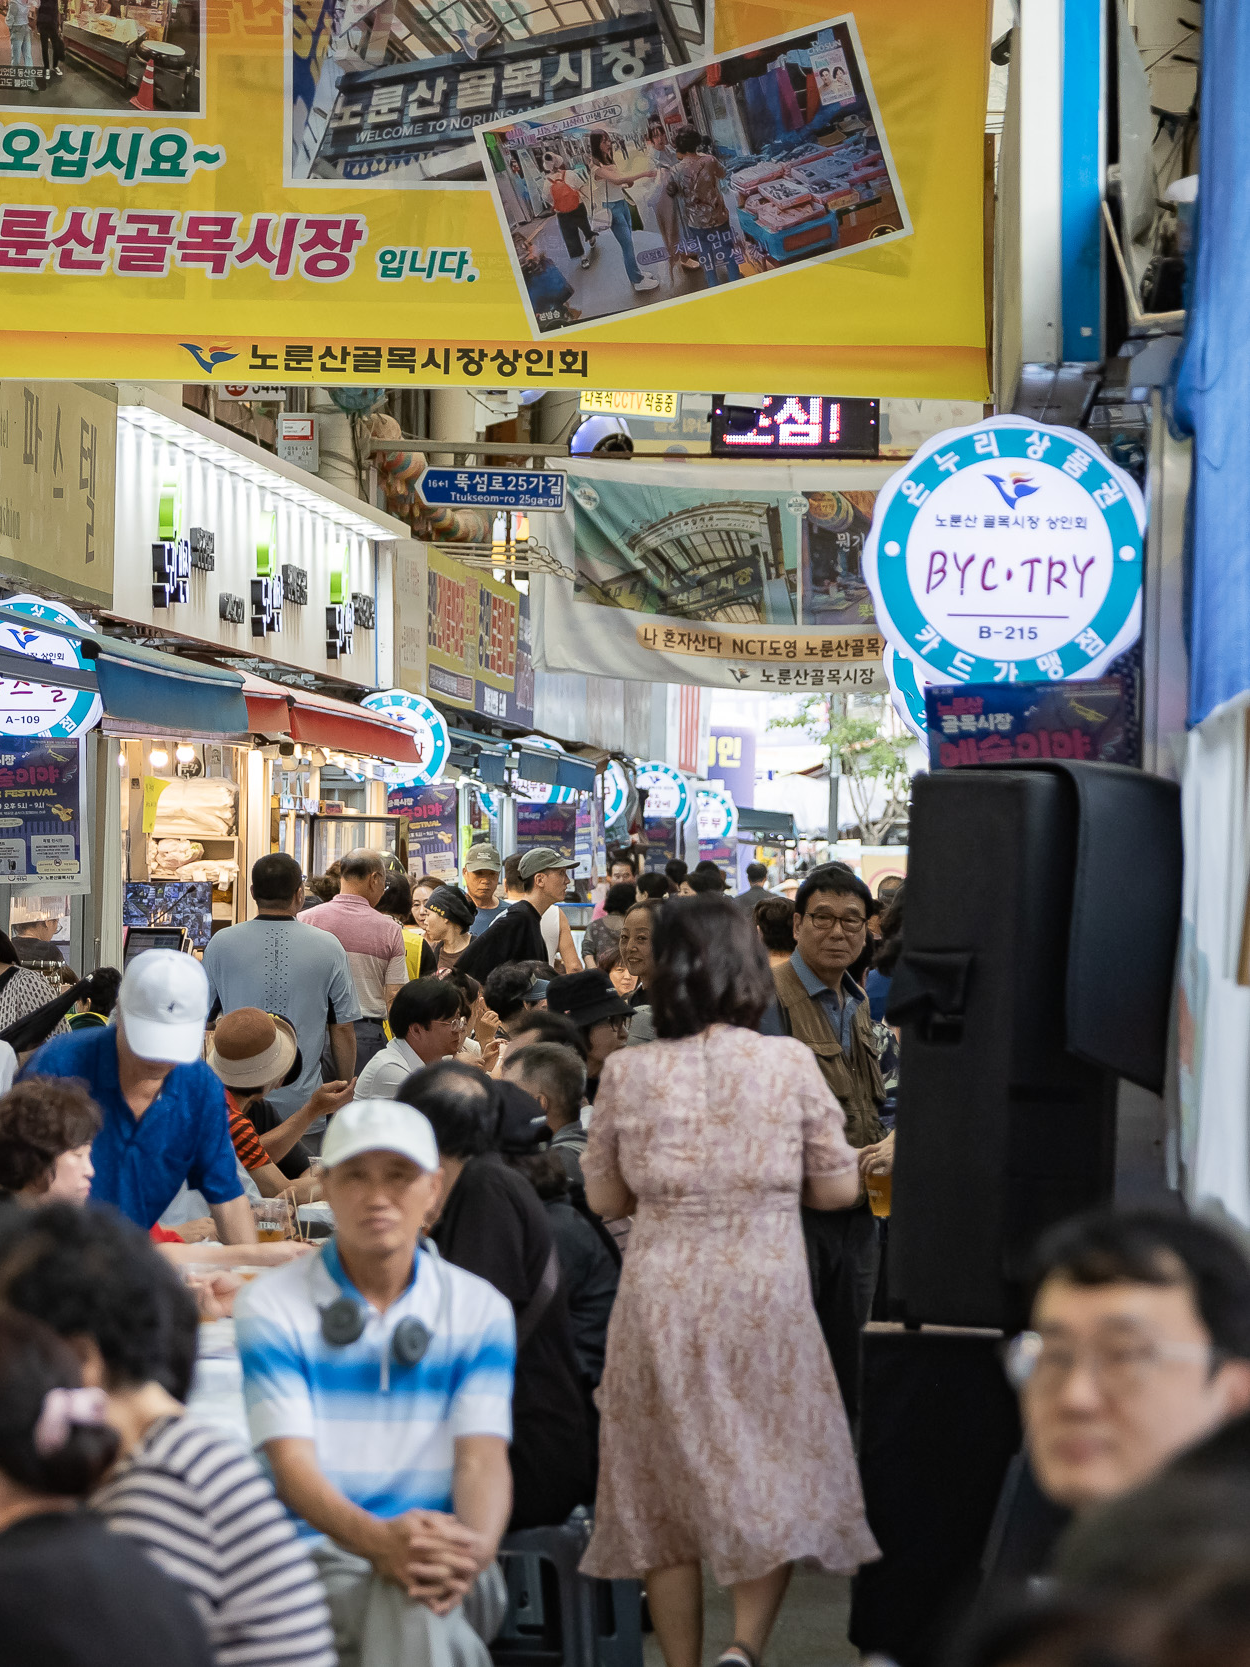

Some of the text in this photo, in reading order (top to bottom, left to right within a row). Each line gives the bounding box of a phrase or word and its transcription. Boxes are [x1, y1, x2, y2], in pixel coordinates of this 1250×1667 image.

[355, 119, 449, 143] WELCOME TO
[378, 249, 477, 283] 입니다.
[249, 344, 589, 379] 노룬산골목시장상인회
[901, 431, 1124, 510] 온누리상품권
[454, 473, 561, 495] 뚝섬로25가길
[451, 491, 561, 508] Ttukseom-ro 25ga-gil
[935, 513, 1088, 531] 노룬산 골목시장 상인회
[643, 628, 658, 646] 나
[663, 629, 722, 654] 혼자산다
[732, 638, 798, 660] NCT도영
[979, 625, 1039, 641] B-215
[915, 623, 1106, 683] 카드가맹점
[760, 667, 876, 687] 노룬산골목시장
[6, 715, 41, 724] A-109
[4, 788, 58, 798] FESTIVAL
